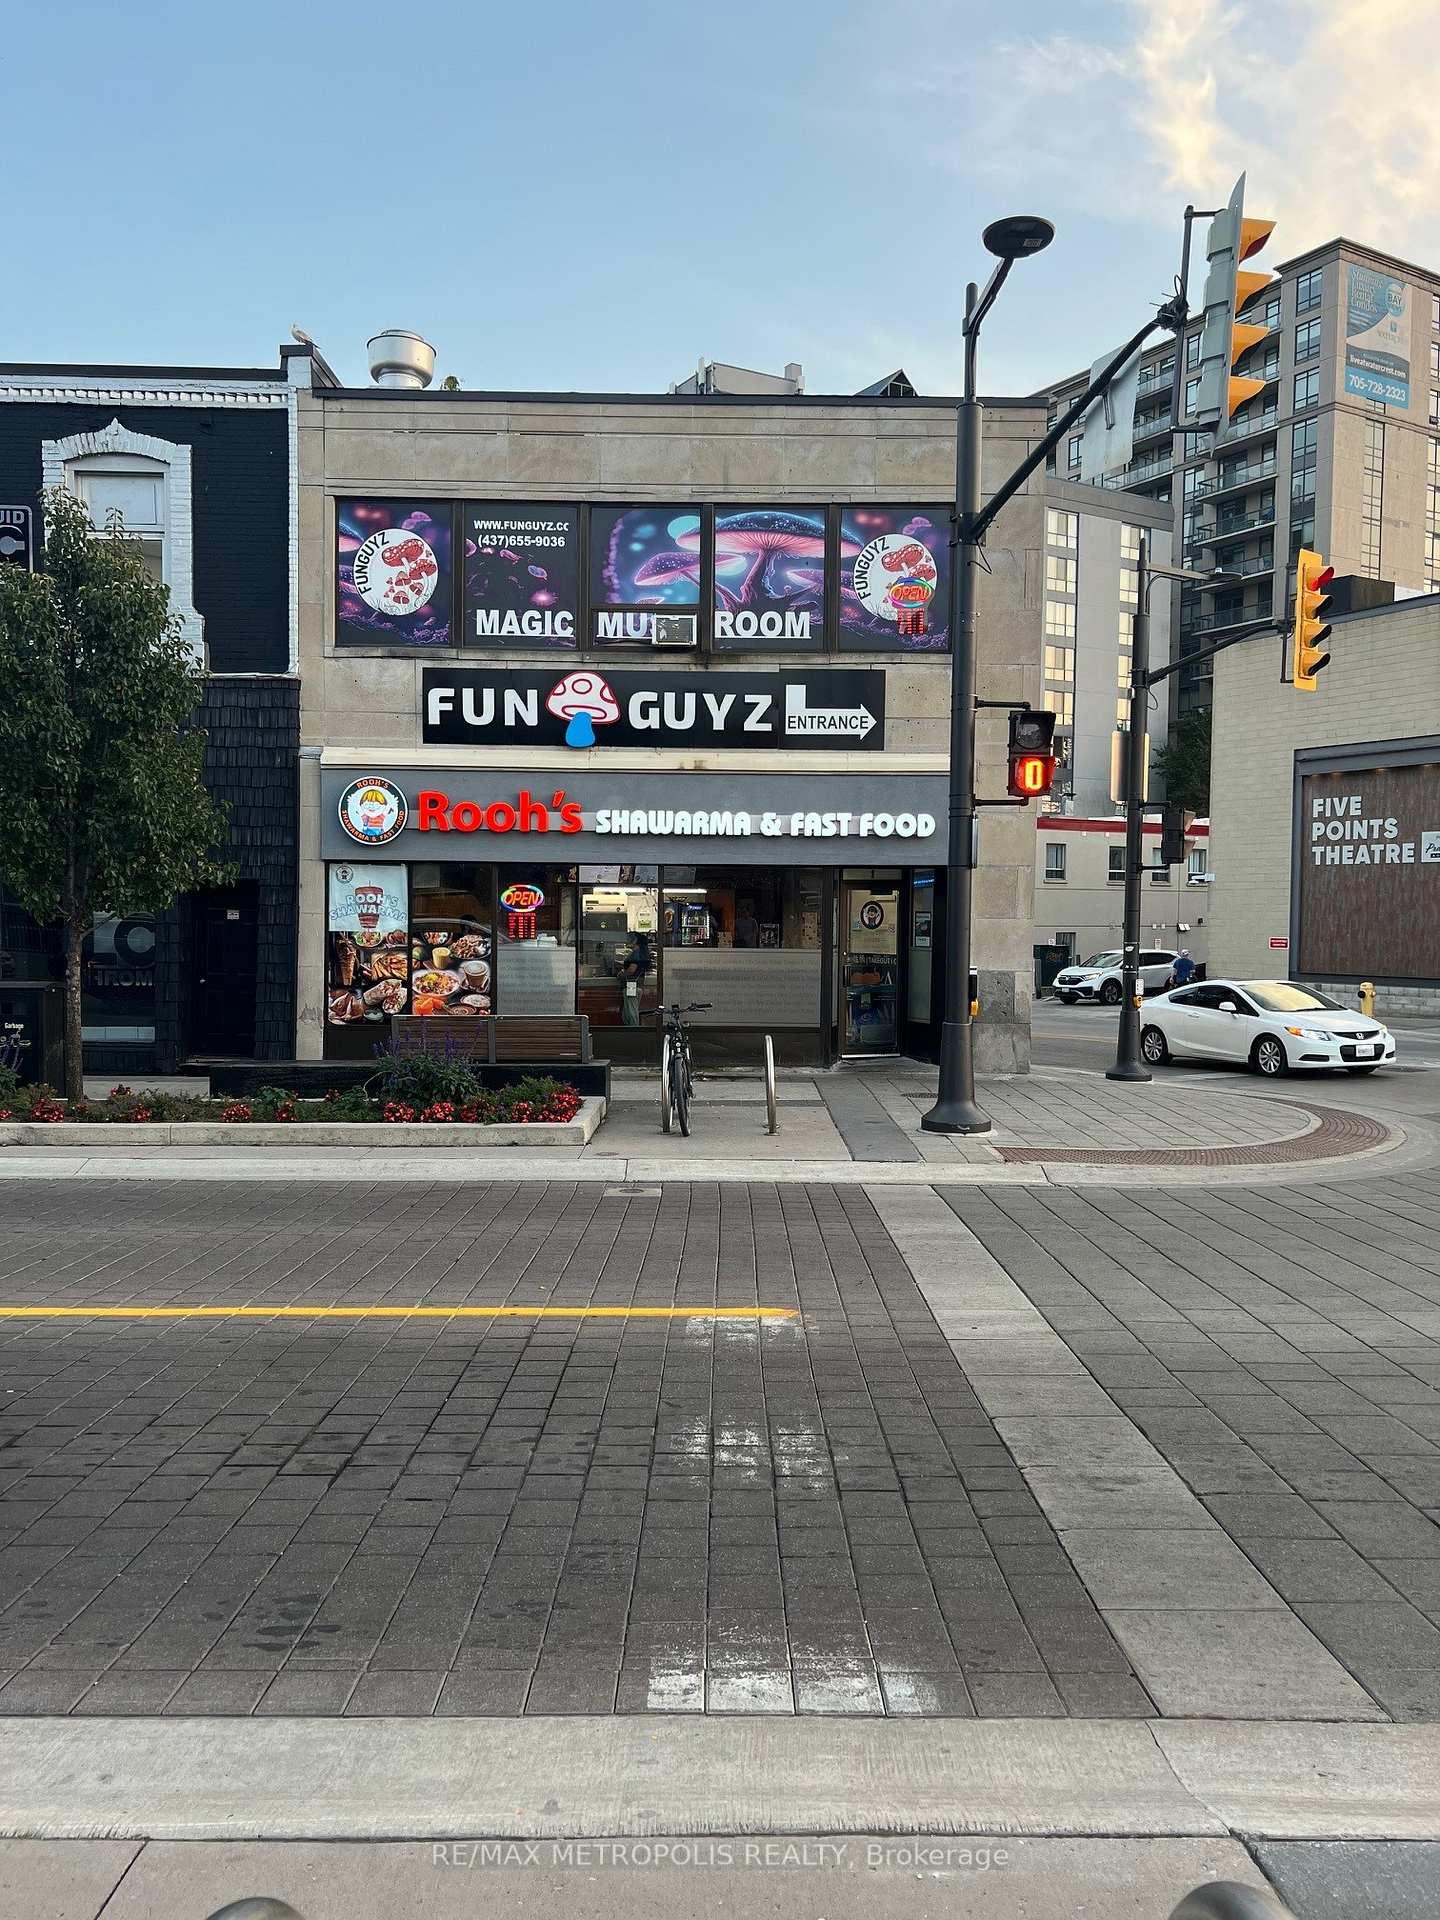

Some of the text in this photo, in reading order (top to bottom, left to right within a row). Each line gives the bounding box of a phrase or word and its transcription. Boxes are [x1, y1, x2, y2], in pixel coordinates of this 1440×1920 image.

[1349, 374, 1406, 402] 705-728-2323
[477, 534, 566, 548] (437)655-9036
[355, 532, 390, 595] FUNGUYZ
[854, 537, 890, 601] FUNGUYZ
[891, 586, 928, 601] OPEN
[476, 609, 575, 636] MAGIC
[714, 611, 811, 638] ROOM
[427, 687, 773, 732] FUN GUYZ
[787, 715, 869, 730] ENTRANCE
[357, 779, 390, 789] ROOH'S
[417, 790, 583, 834] Rooh's
[1312, 796, 1362, 818] FIVE
[341, 809, 370, 841] SHAWARMA
[379, 829, 396, 841] FAST
[595, 809, 936, 838] SHAWARMA & FAST FOOD
[1312, 818, 1398, 842] POINTS
[1312, 843, 1415, 866] THEATRE
[346, 893, 400, 908] ROOH'S
[504, 891, 540, 906] OPEN
[329, 903, 407, 922] SHAWARMA
[4, 1022, 25, 1032] Garbage
